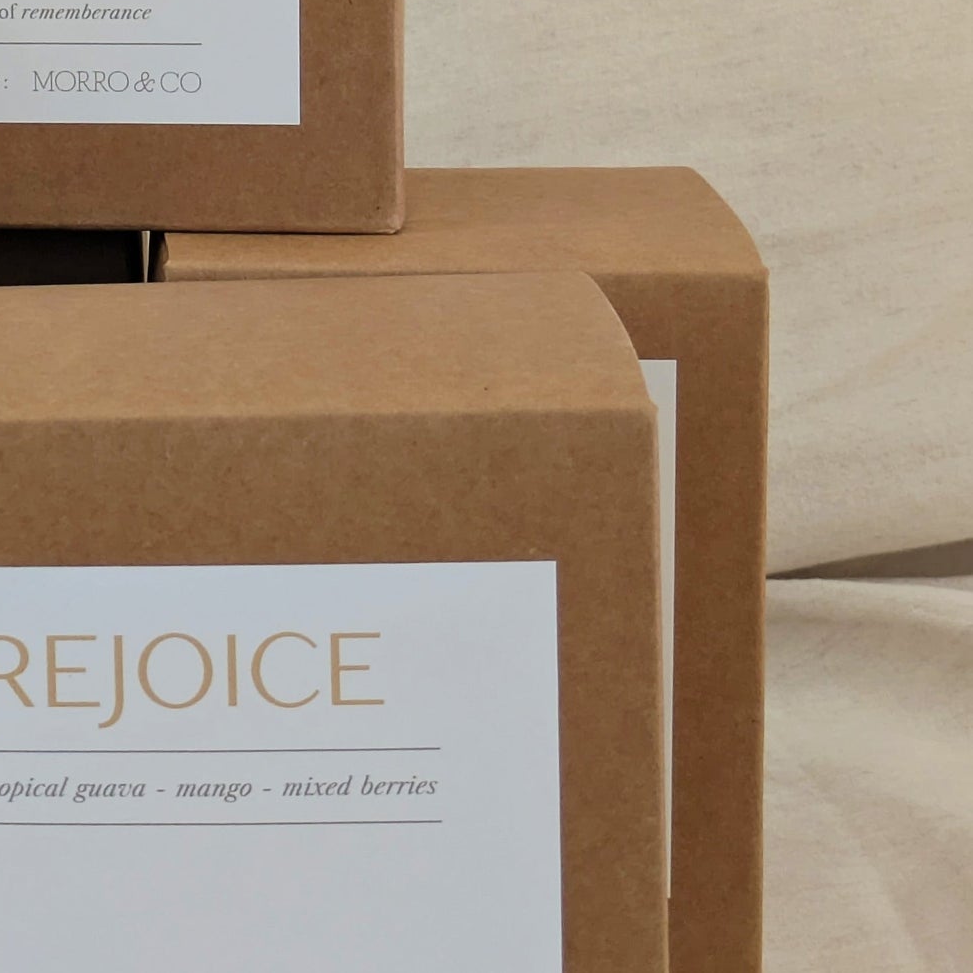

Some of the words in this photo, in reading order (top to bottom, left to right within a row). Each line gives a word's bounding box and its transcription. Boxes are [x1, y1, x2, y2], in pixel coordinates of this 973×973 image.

[21, 4, 152, 20] rememberance
[73, 780, 146, 803] guava
[176, 781, 252, 803] mango
[282, 776, 351, 798] mixed
[360, 775, 438, 797] berries
